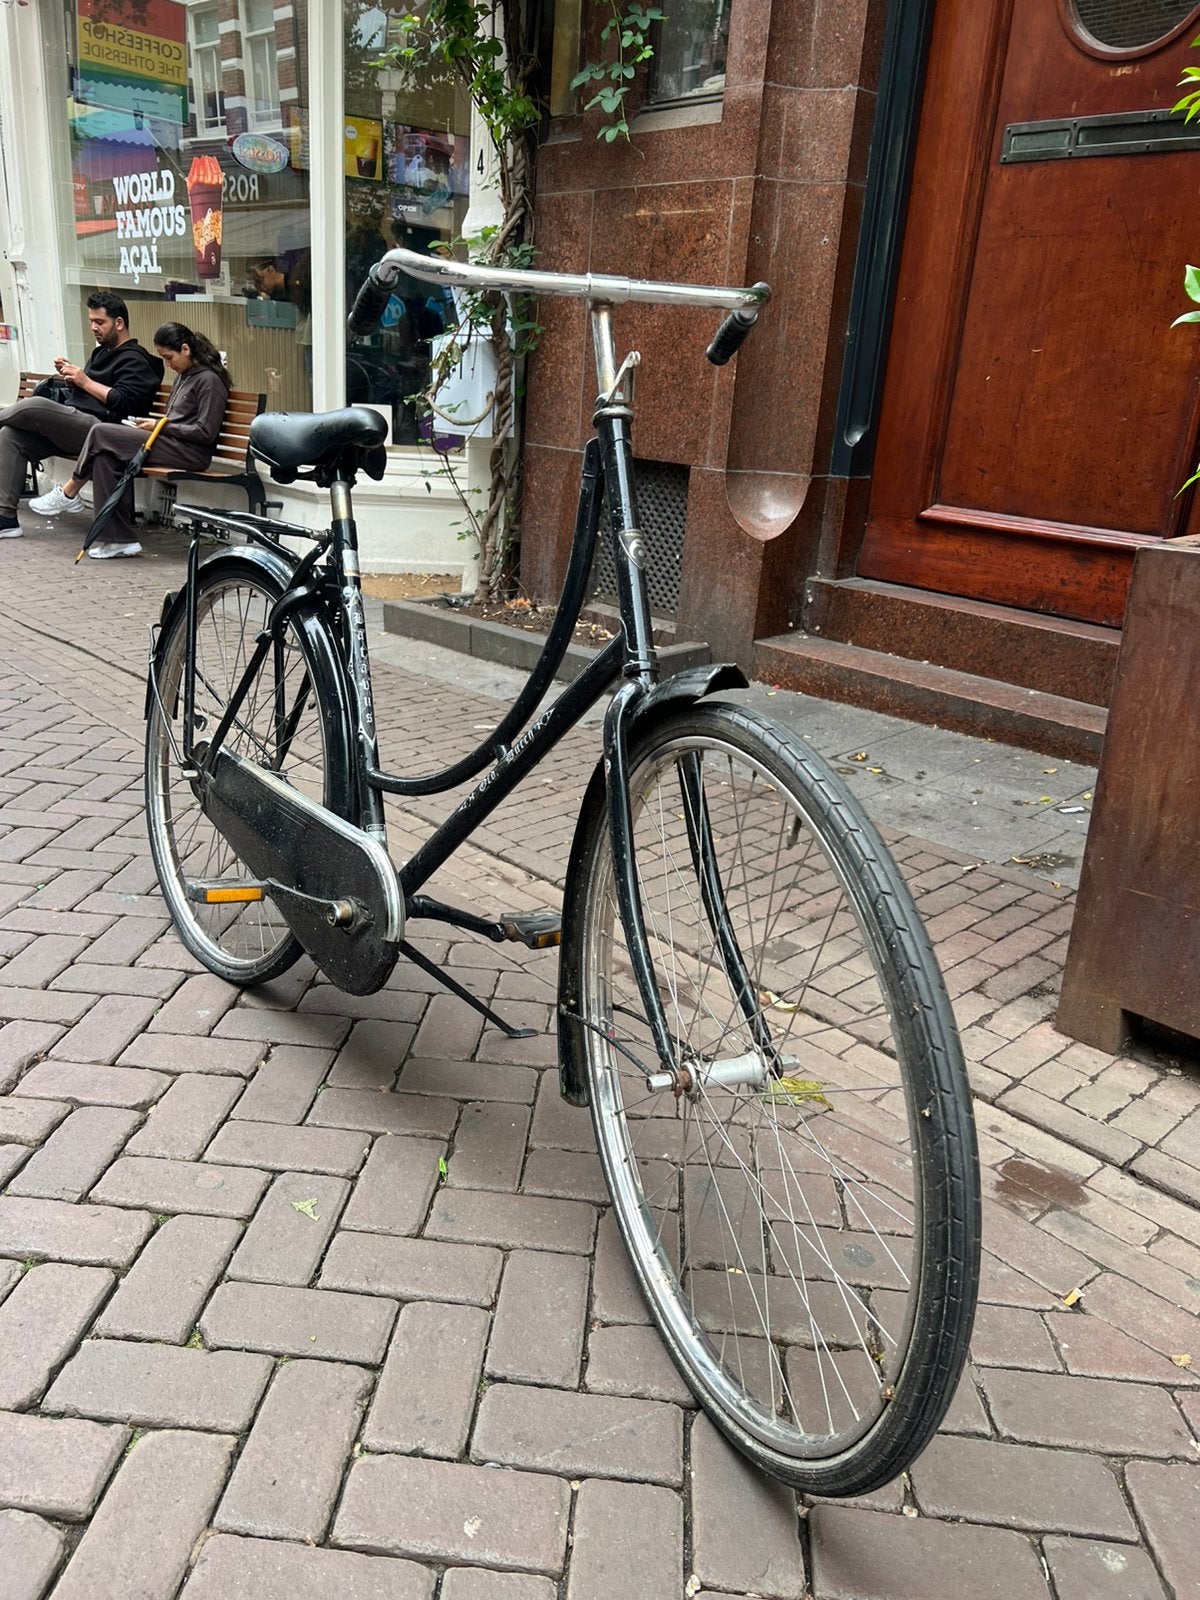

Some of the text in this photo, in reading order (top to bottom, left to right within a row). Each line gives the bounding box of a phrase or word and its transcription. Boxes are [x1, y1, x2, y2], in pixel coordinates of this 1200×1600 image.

[477, 148, 484, 175] 4
[112, 169, 175, 205] WORLD
[115, 204, 187, 239] FAMOUS
[397, 204, 418, 212] OPEN
